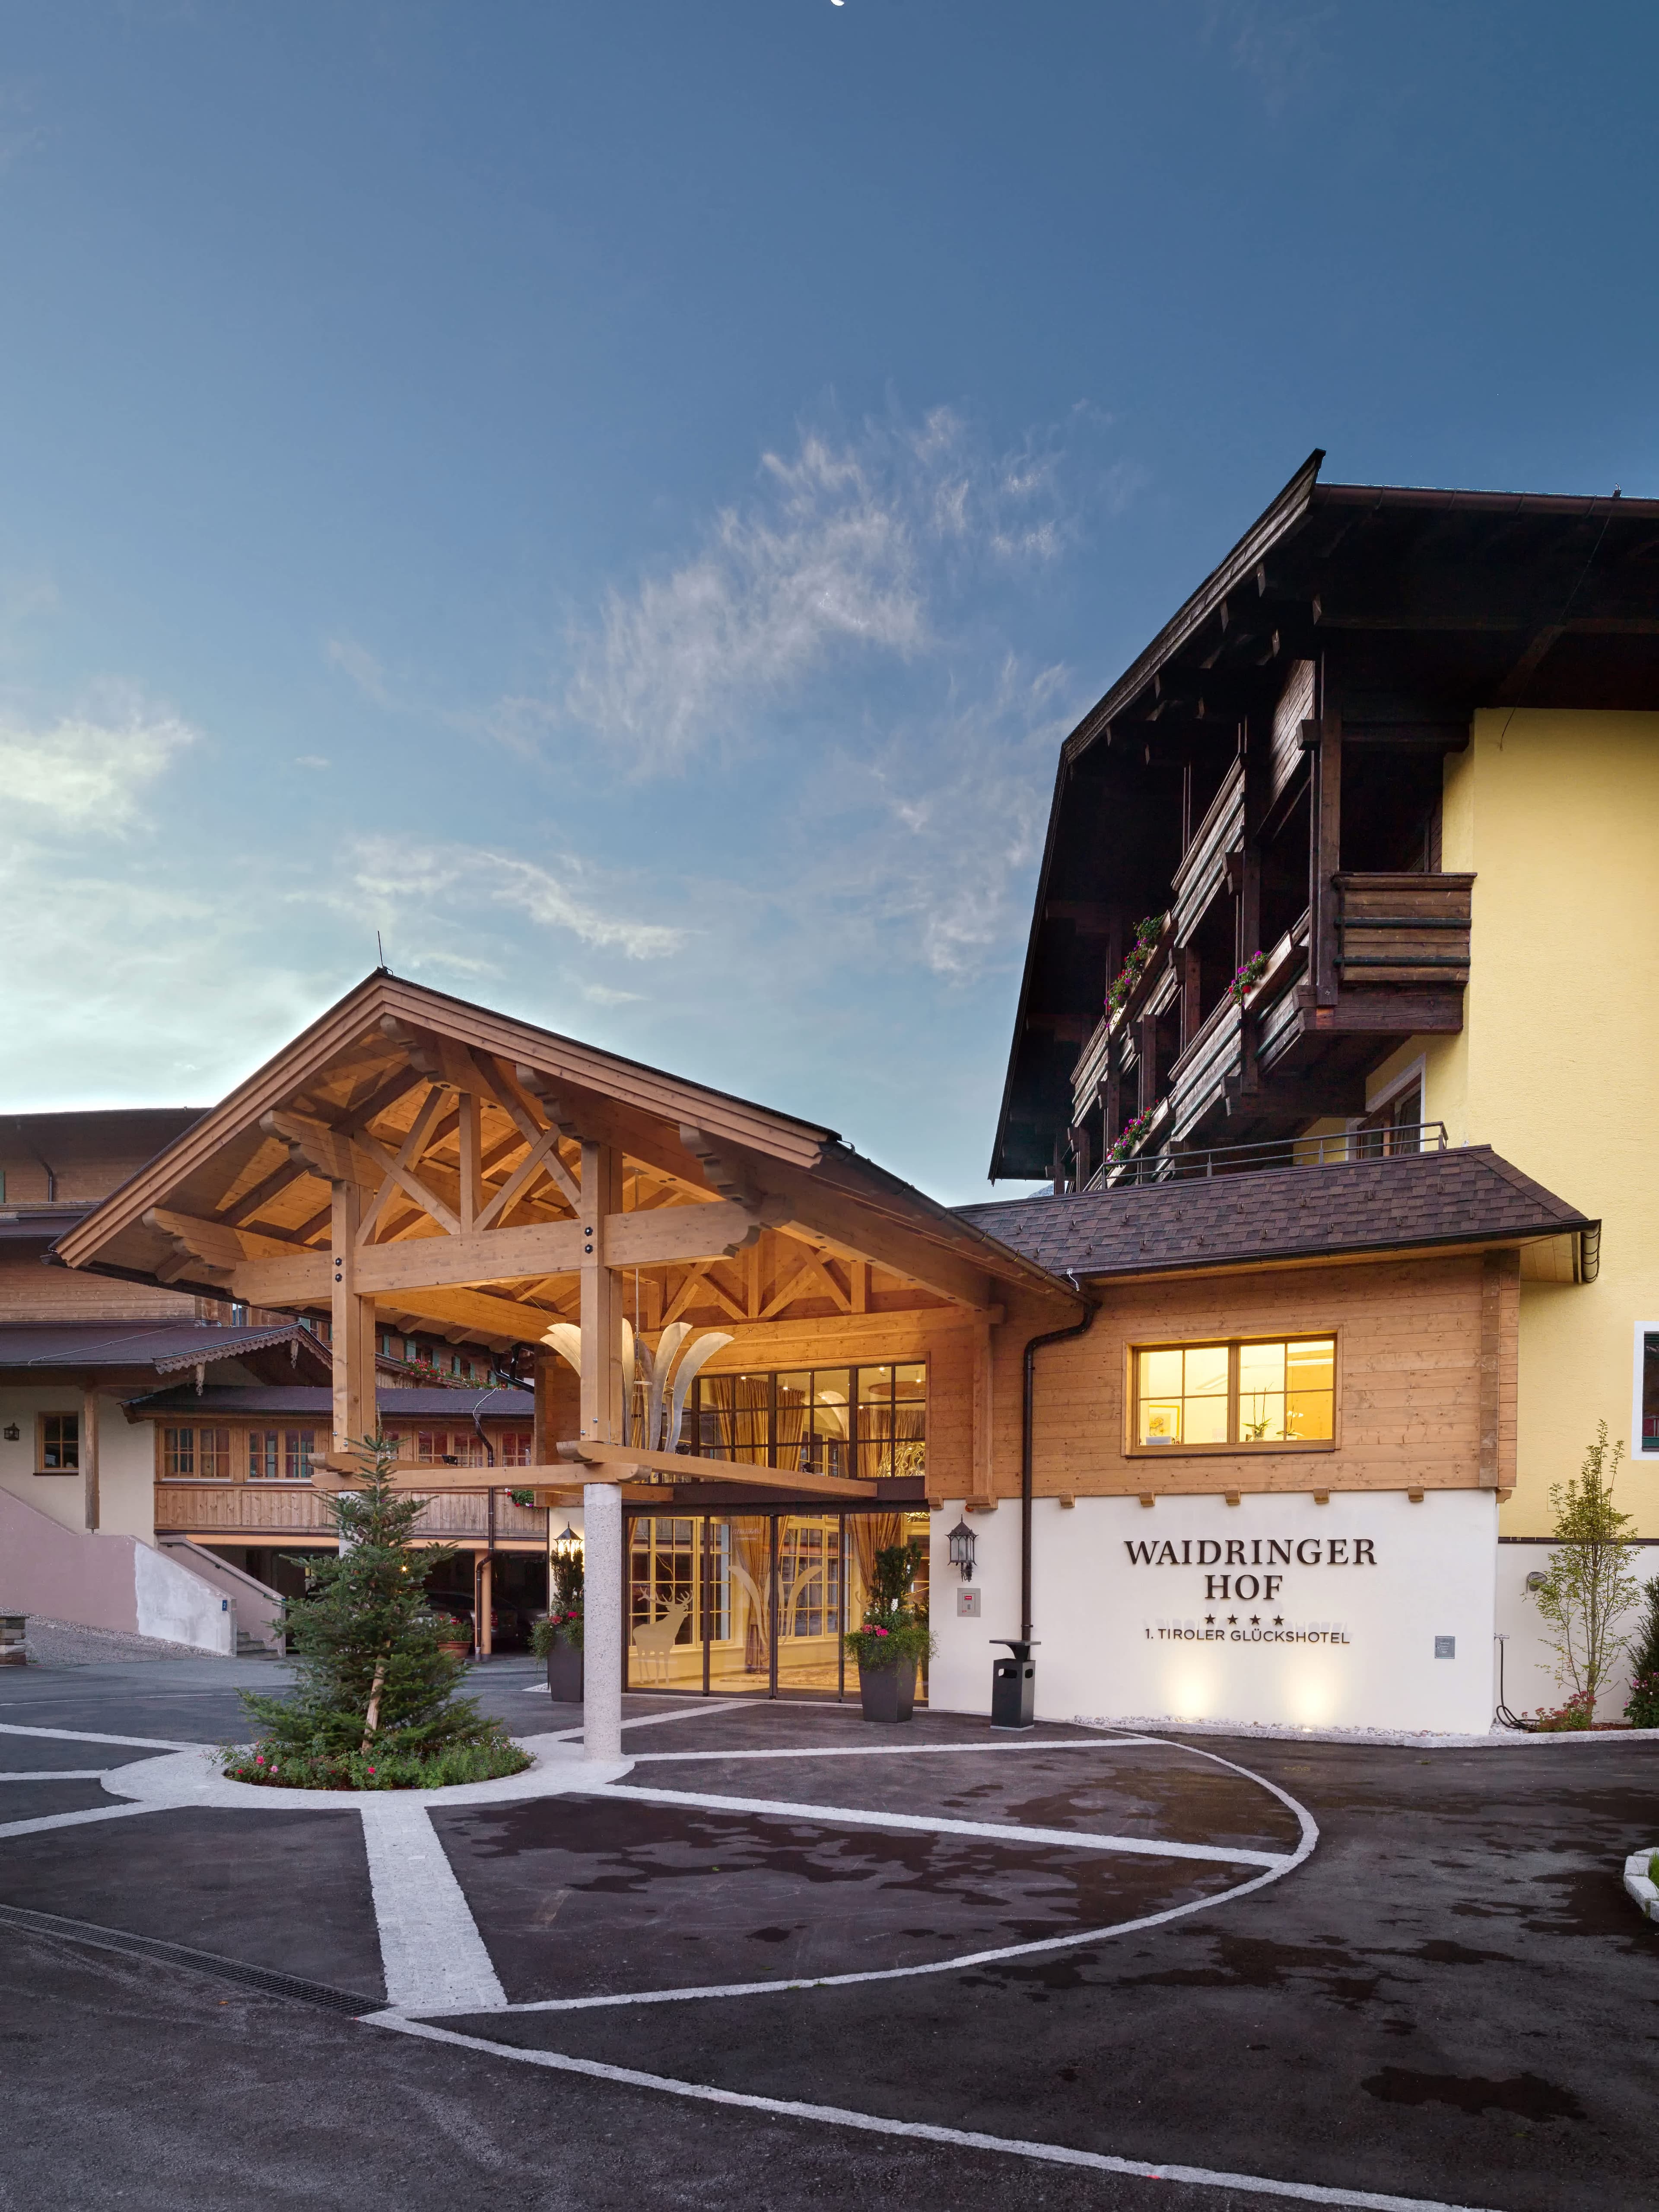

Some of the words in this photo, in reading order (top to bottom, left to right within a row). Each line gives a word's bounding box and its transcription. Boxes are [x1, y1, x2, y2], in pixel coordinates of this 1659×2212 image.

[1123, 1539, 1378, 1565] WAIDRINGER
[1205, 1574, 1283, 1600] HOF
[1145, 1628, 1154, 1639] 1.
[1157, 1628, 1225, 1640] TIROLER
[1230, 1628, 1350, 1643] GLÜCKSHOTEL
